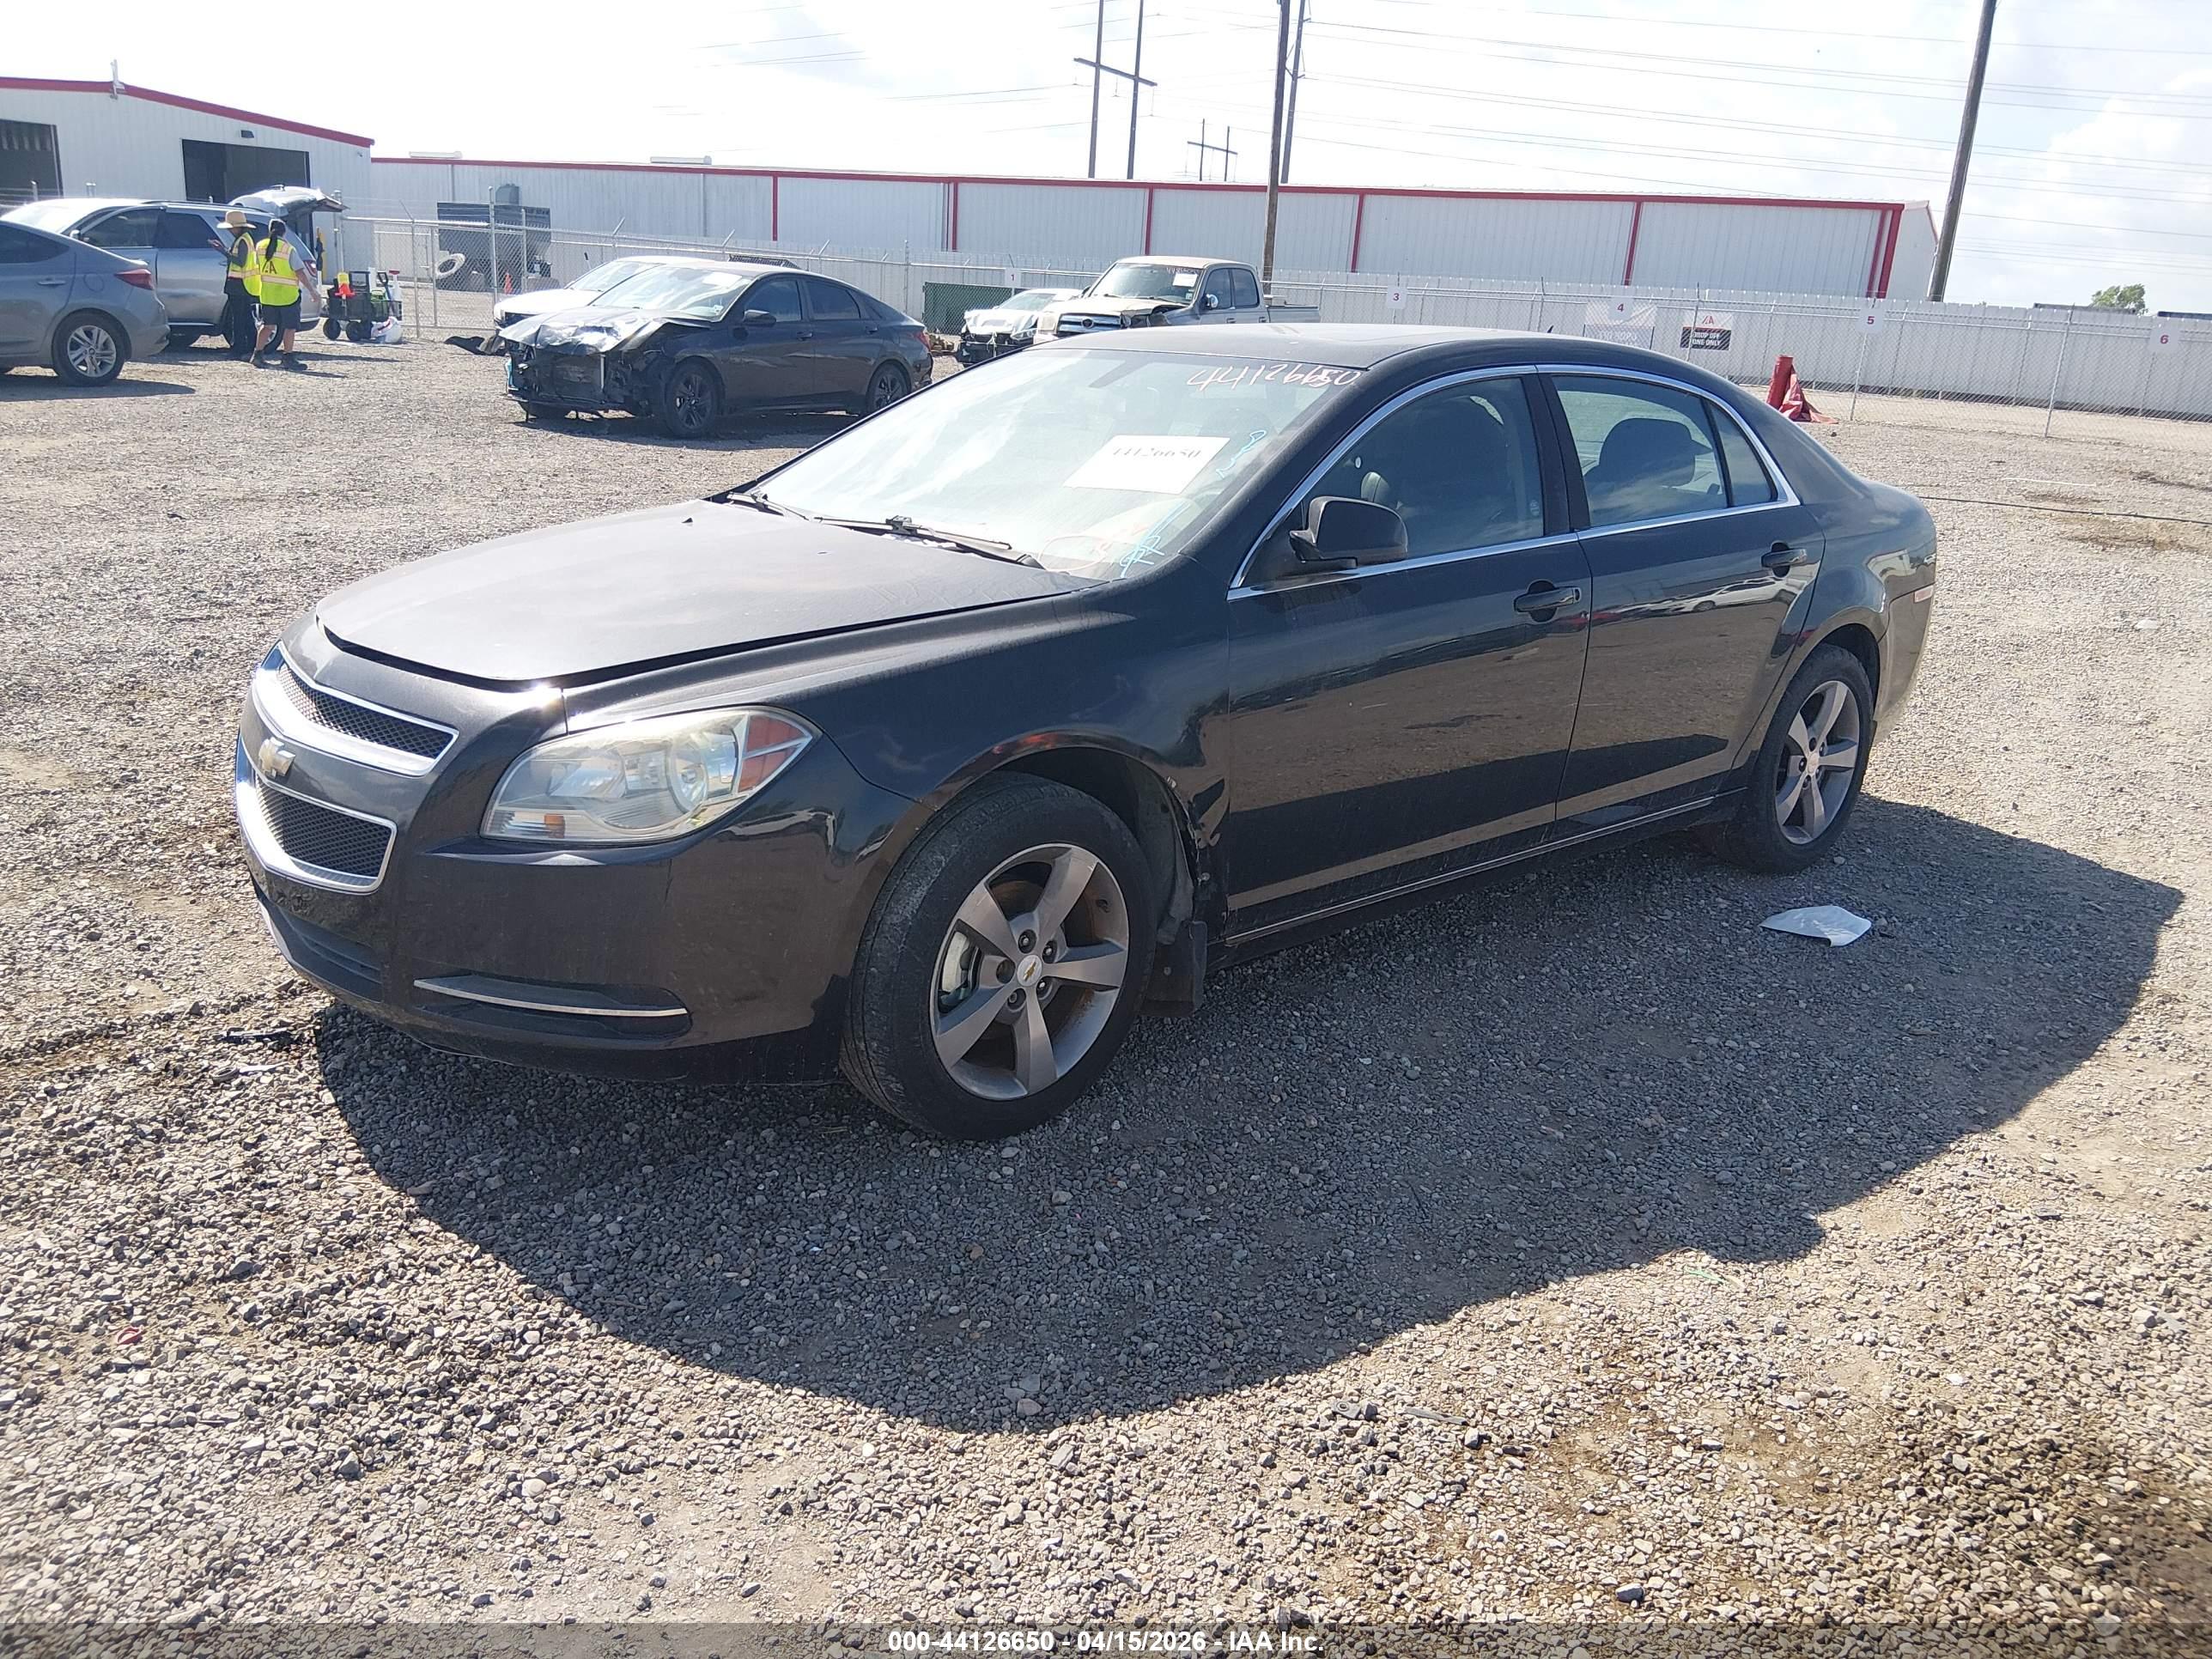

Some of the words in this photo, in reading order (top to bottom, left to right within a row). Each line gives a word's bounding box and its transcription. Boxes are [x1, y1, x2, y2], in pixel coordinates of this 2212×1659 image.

[1617, 303, 1624, 312] 4
[1867, 315, 1875, 325] 5
[2160, 334, 2168, 344] 6
[1187, 363, 1362, 391] 44126650
